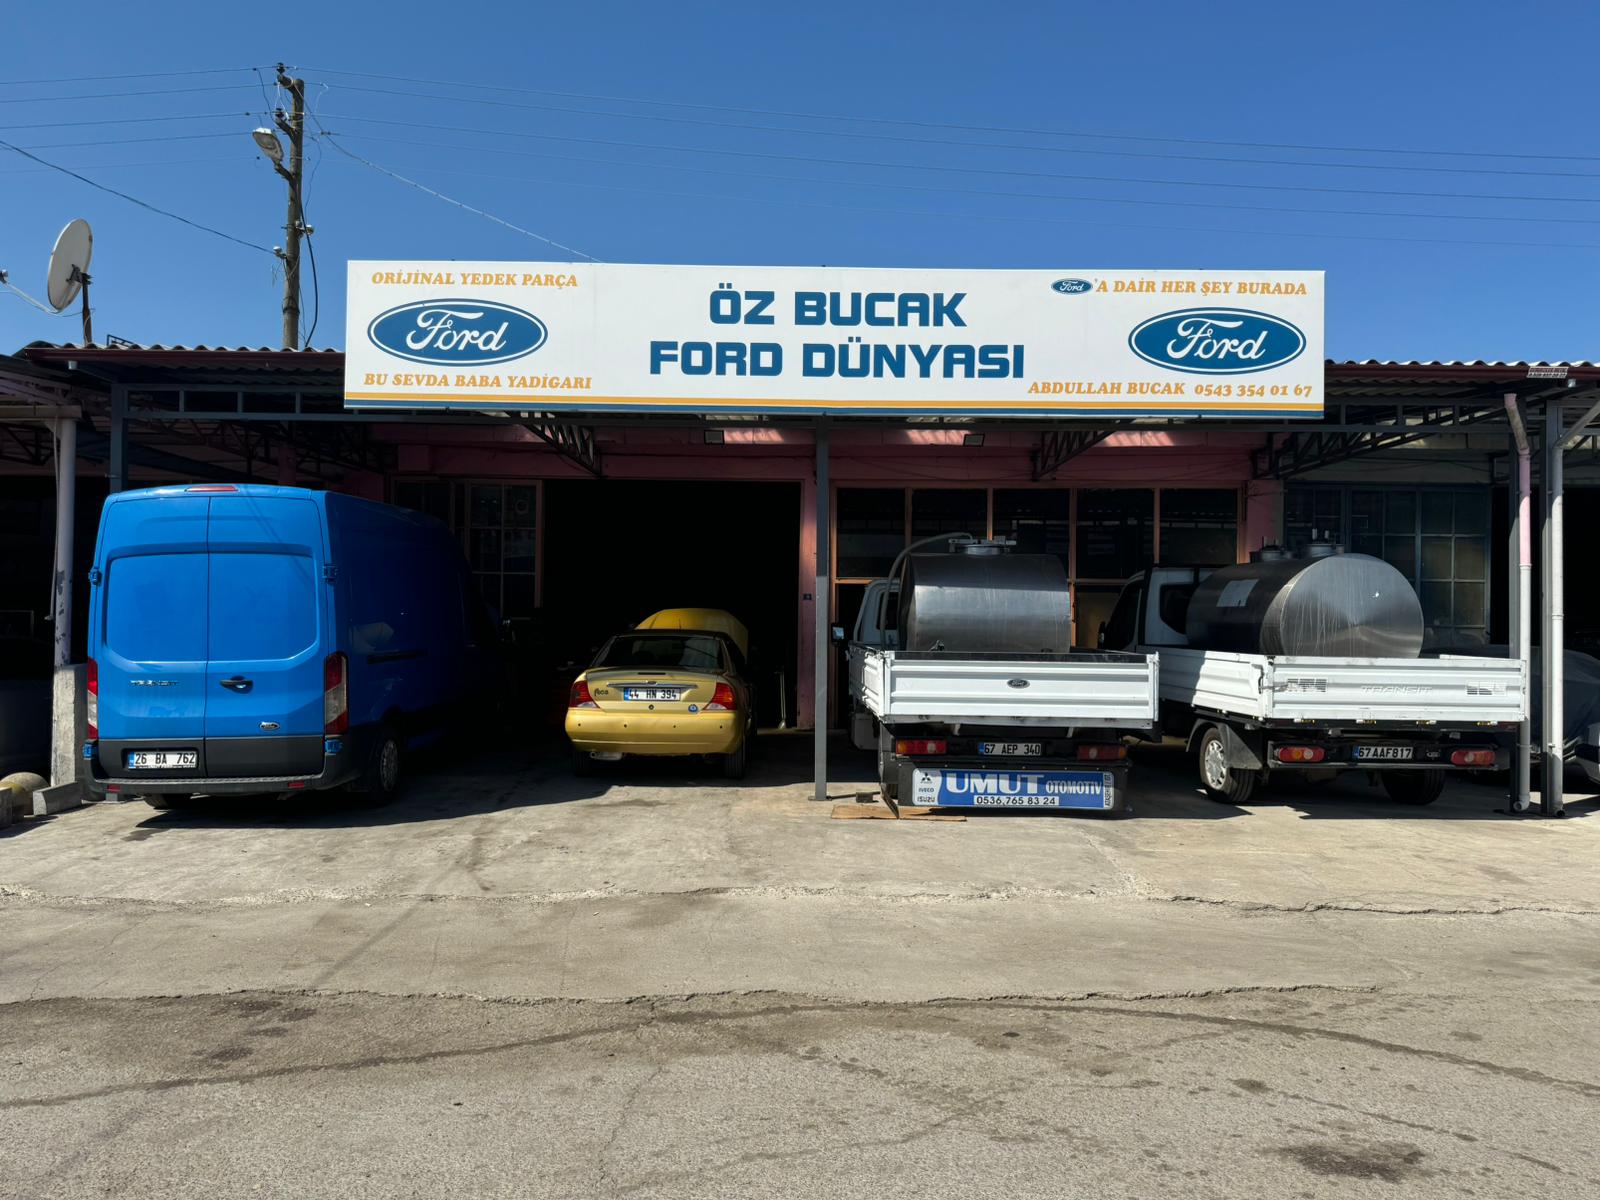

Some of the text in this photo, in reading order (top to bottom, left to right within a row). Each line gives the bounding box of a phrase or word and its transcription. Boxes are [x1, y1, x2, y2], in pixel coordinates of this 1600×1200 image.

[371, 270, 578, 290] ORİJİNAL YEDEK PARÇA
[1113, 278, 1156, 293] DAİR
[1160, 281, 1196, 293] HER
[1200, 282, 1233, 297] ŞEY
[1236, 282, 1307, 295] BURADA
[709, 283, 968, 327] ÖZ BUCAK
[405, 309, 509, 351] Ford
[1166, 318, 1268, 360] Ford
[650, 336, 1025, 379] FORD DÜNYASI
[364, 373, 389, 386] BU
[392, 374, 450, 387] SEVDA
[454, 375, 502, 388] BABA
[1028, 382, 1313, 398] ABDULLAH BUCAK 0543 354 01 67
[629, 689, 677, 699] 44 HN 394
[984, 743, 1040, 755] 67 AEP 340
[135, 753, 195, 765] 26 BA 762
[946, 772, 1044, 794] UMUT
[1027, 796, 1040, 805] 83
[1042, 796, 1056, 805] 24
